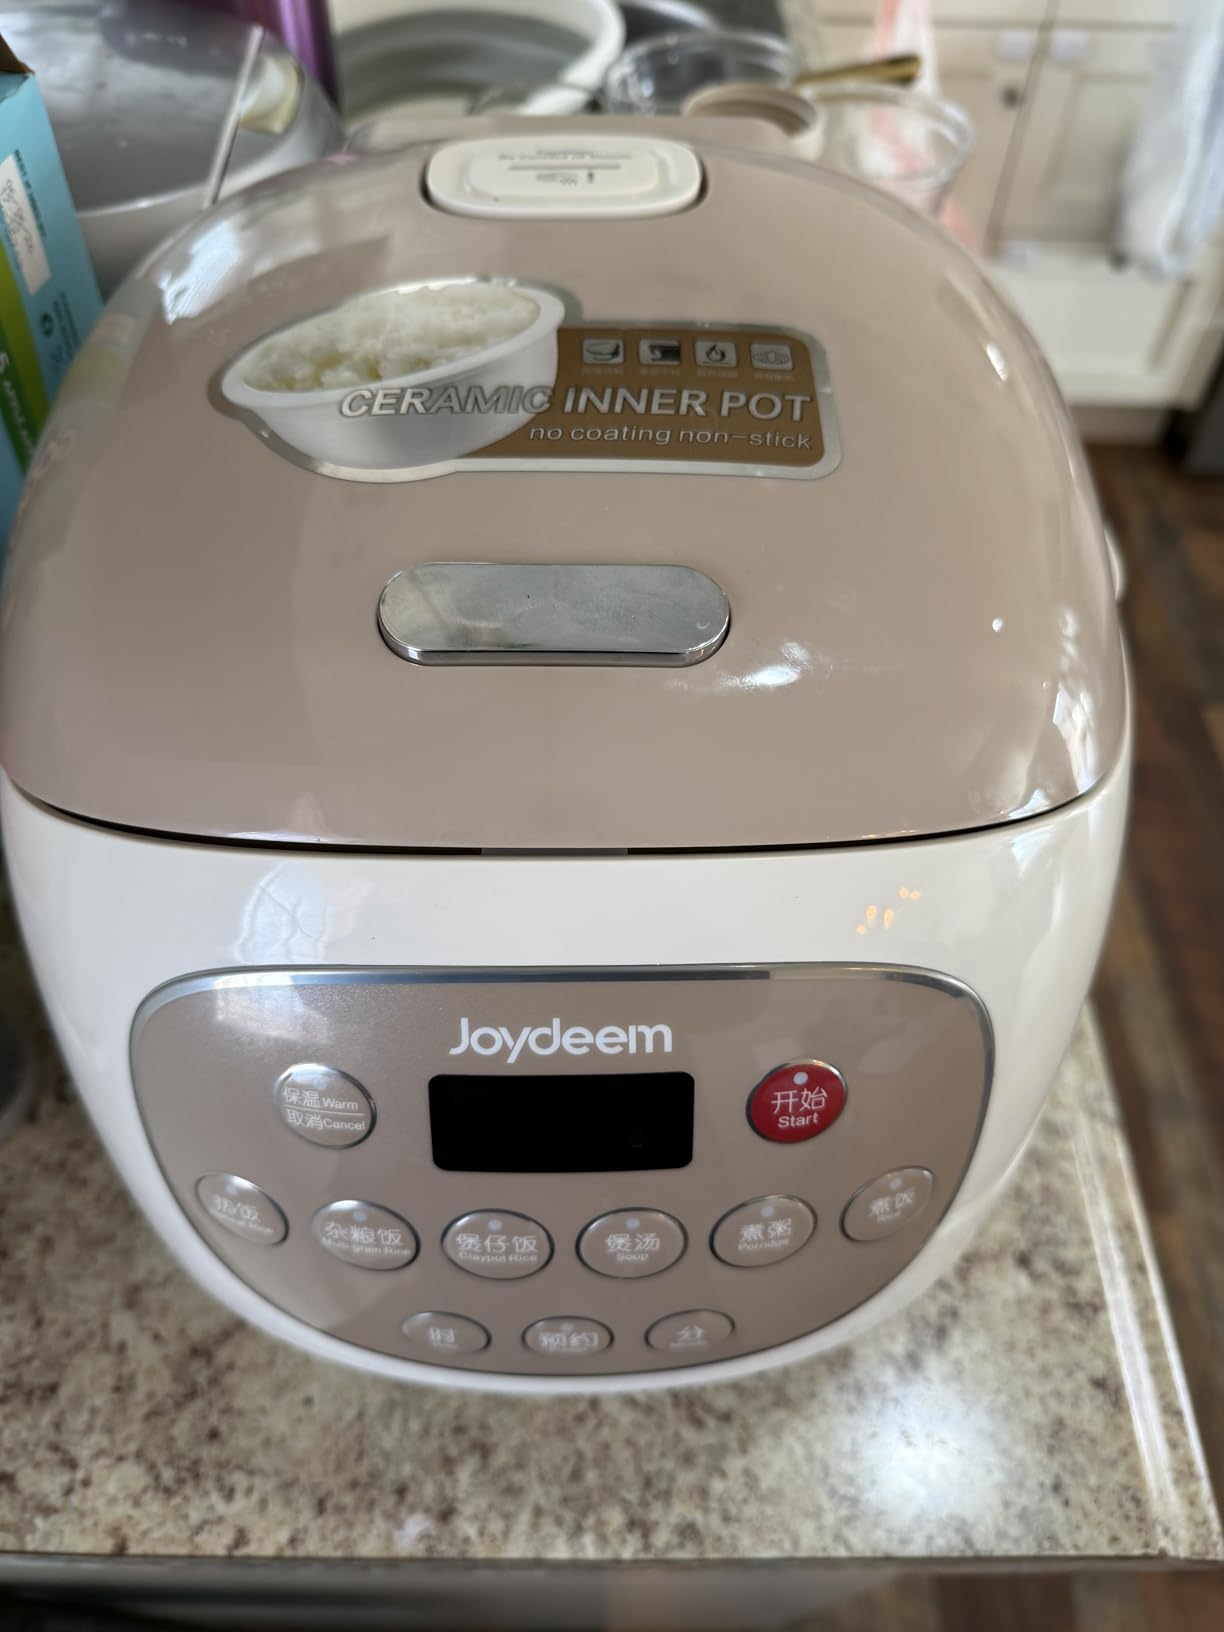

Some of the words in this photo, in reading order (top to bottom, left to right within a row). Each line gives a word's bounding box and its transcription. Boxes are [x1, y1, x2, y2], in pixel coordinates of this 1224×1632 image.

[340, 385, 551, 417] CERAMIC
[564, 386, 707, 417] INNER
[720, 390, 811, 421] POT
[529, 426, 563, 441] no
[570, 425, 671, 445] coating
[449, 1017, 673, 1063] Joydeem
[283, 1087, 320, 1108] 保温
[322, 1097, 359, 1111] Warm
[771, 1086, 828, 1114] 开始
[286, 1108, 323, 1130] 取消
[323, 1118, 366, 1130] Cancel
[778, 1112, 819, 1128] Start
[456, 1233, 538, 1253] 煲仔饭
[606, 1232, 661, 1252] 煲汤
